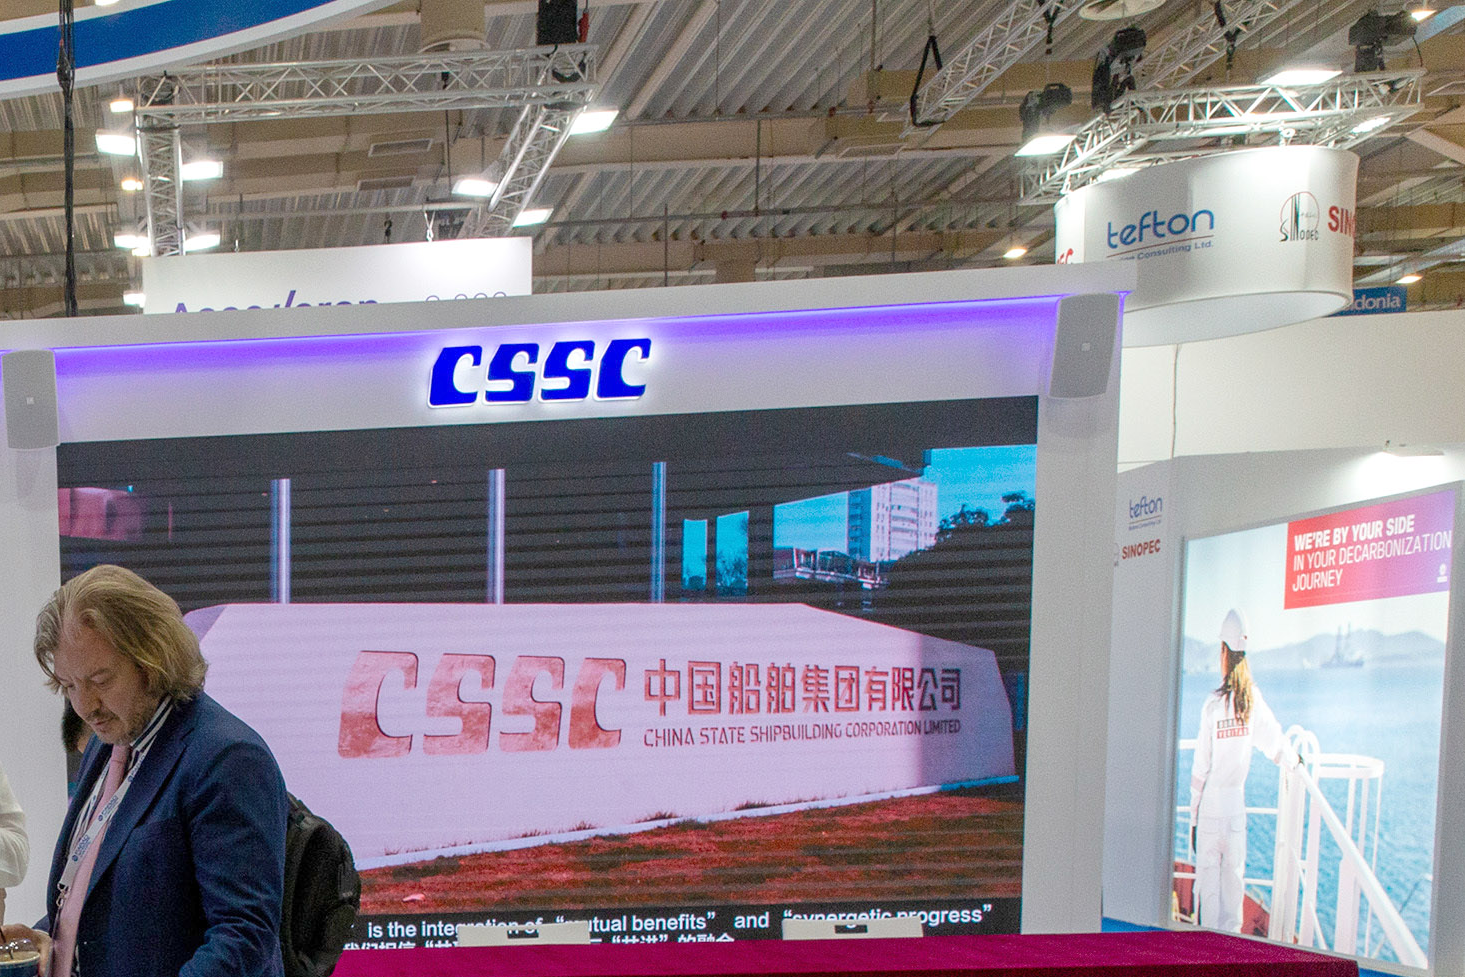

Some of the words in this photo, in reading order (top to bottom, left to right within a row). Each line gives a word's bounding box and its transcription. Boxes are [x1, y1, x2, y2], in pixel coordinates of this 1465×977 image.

[1107, 208, 1215, 249] tefton
[1137, 244, 1192, 260] Consulting
[1354, 294, 1401, 311] donia
[428, 337, 653, 408] CSSC
[1129, 496, 1163, 519] tefton
[1333, 526, 1349, 546] BY
[1352, 522, 1383, 542] YOUR
[1386, 514, 1415, 537] SIDE
[1122, 539, 1161, 560] SINOPEC
[1293, 554, 1305, 572] IN
[1307, 550, 1336, 569] YOUR
[1339, 530, 1452, 566] DECARBONIZATION
[1292, 568, 1343, 592] JOURNEY
[644, 658, 961, 717] 中国船舶集团有限公司
[338, 650, 628, 758] CSSC
[644, 728, 695, 748] CHINA
[700, 726, 746, 745] STATE
[750, 722, 842, 743] SHIPBUILDING
[845, 720, 921, 738] CORPORATION
[924, 718, 961, 735] LIMITED
[367, 922, 384, 938] is
[387, 921, 417, 938] the
[734, 911, 770, 929] and
